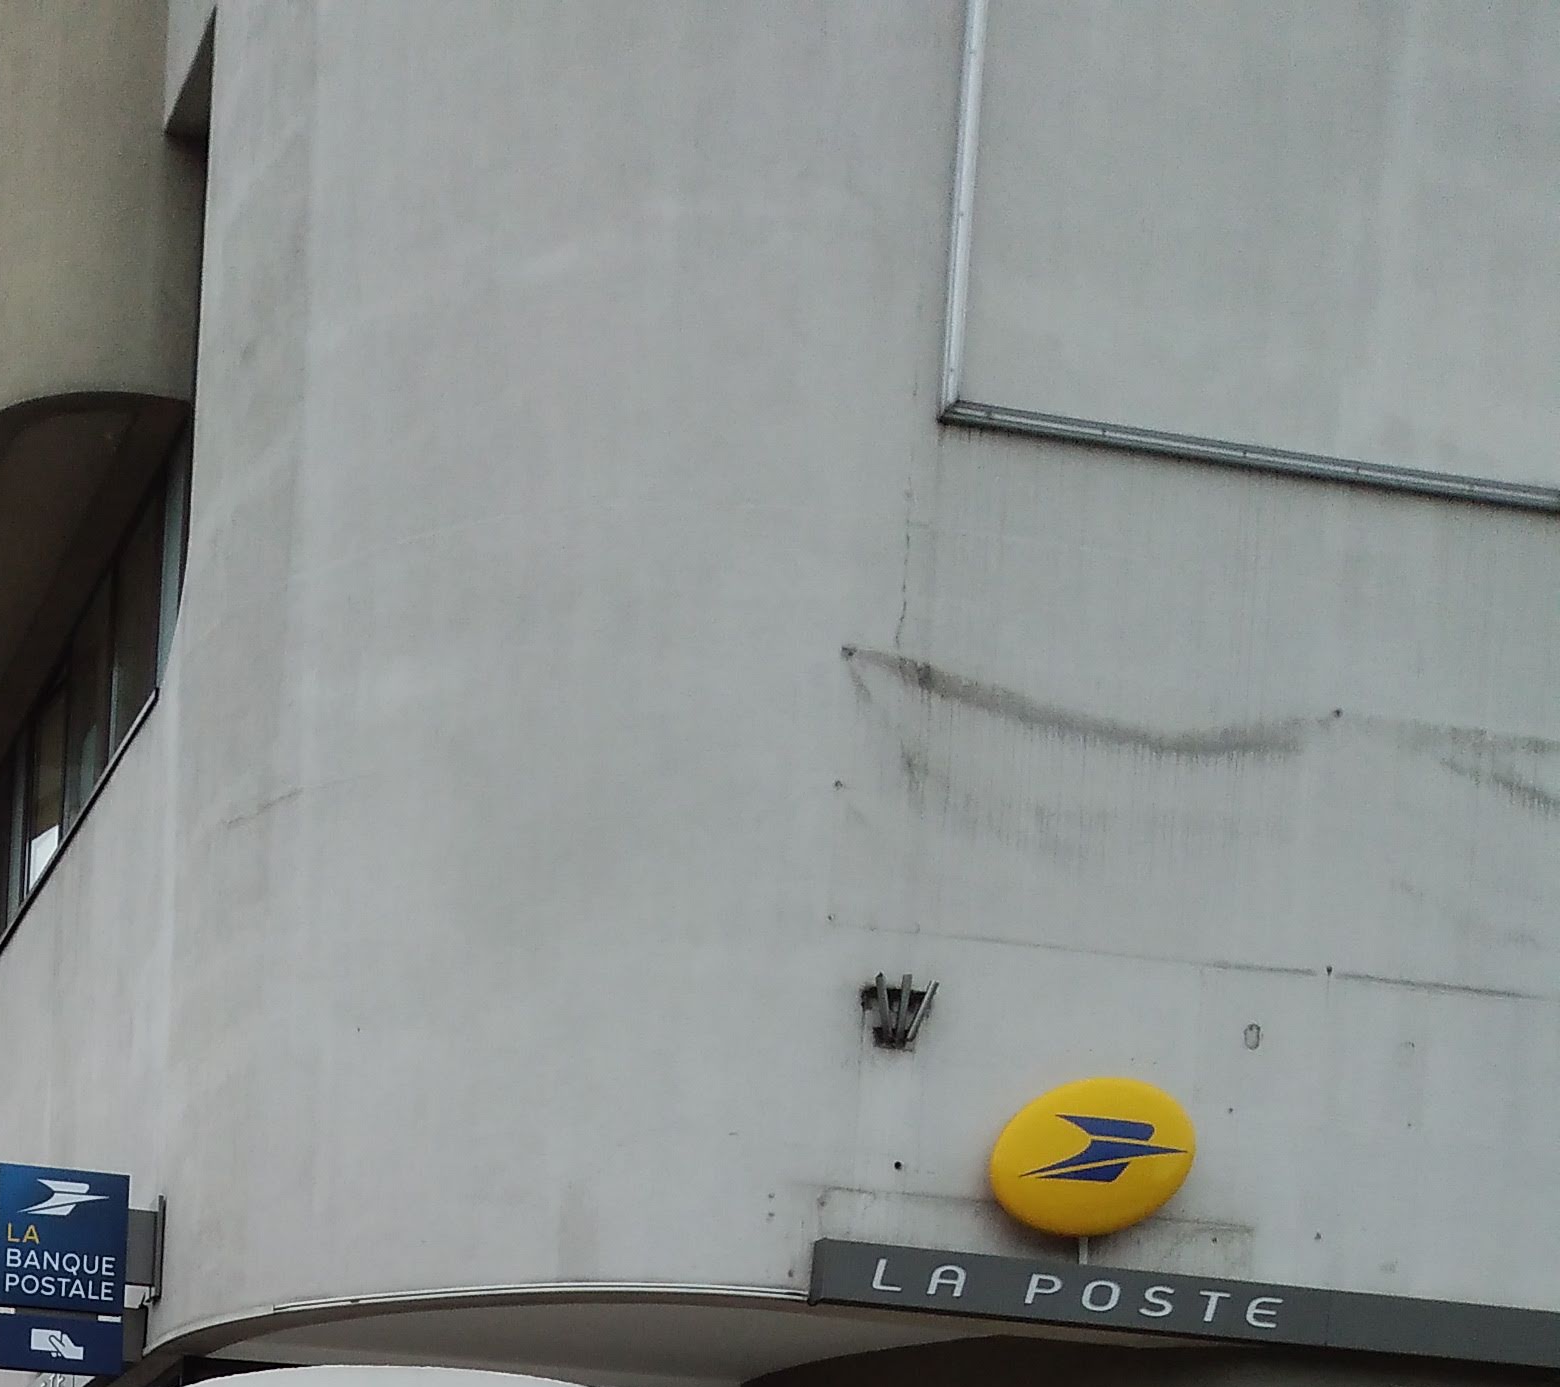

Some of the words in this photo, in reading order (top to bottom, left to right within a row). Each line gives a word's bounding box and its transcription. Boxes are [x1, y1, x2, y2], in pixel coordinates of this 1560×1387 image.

[6, 1222, 40, 1244] LA
[5, 1248, 117, 1277] BANQUE
[4, 1273, 115, 1302] POSTALE
[871, 1257, 968, 1298] LA
[1024, 1272, 1284, 1329] POSTE
